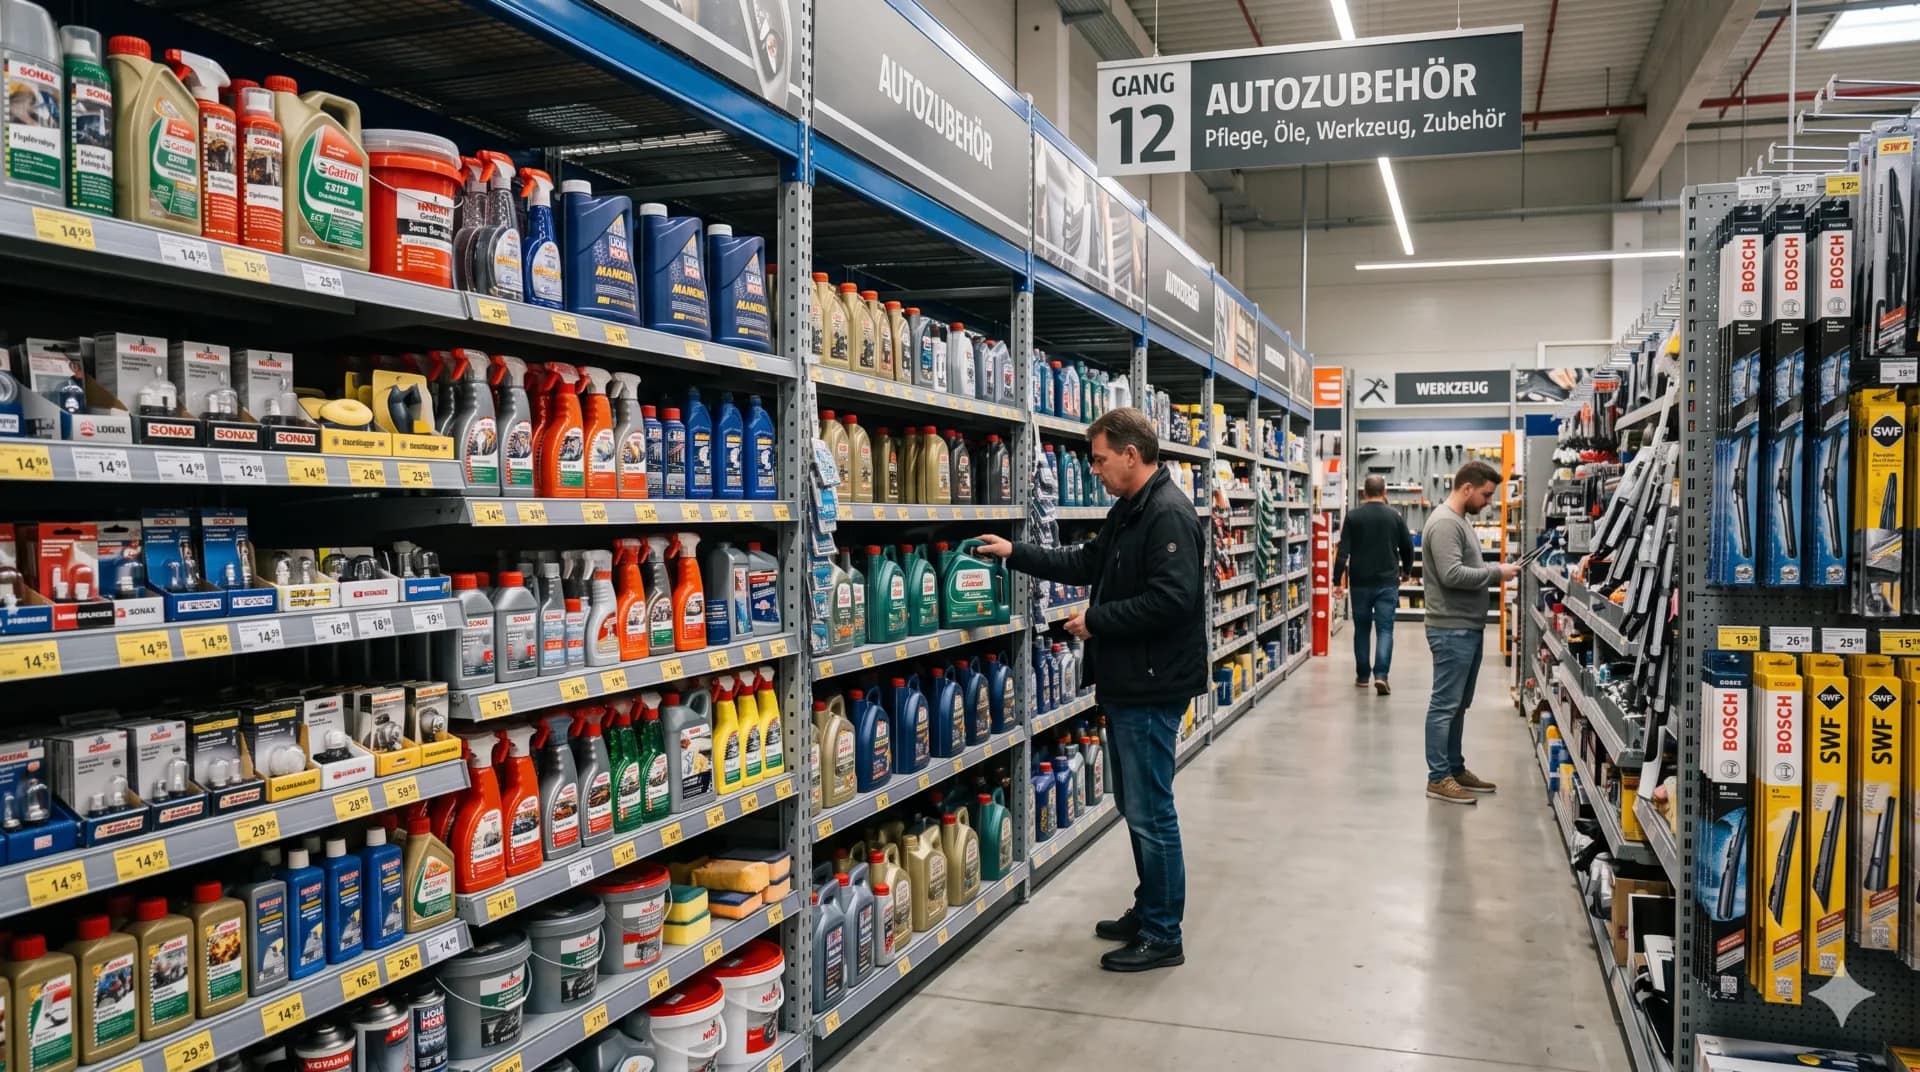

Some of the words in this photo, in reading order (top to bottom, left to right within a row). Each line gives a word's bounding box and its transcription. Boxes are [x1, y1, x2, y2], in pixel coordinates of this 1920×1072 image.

[1112, 72, 1174, 98] GANG
[1206, 57, 1477, 116] AUTOZUBEHÖR
[878, 53, 993, 170] AUTOZUBEHÖR
[1109, 104, 1175, 164] 12
[1205, 126, 1268, 149] Pflege,
[1274, 120, 1310, 145] Öle,
[1317, 116, 1416, 142] Werkzeug,
[1423, 109, 1507, 133] Zubehör
[1742, 239, 1756, 292] BOSCH
[1785, 237, 1798, 291] BOSCH
[1830, 235, 1844, 289] BOSCH
[1416, 381, 1489, 396] WERKZEUG
[150, 425, 193, 437] SONAX
[217, 429, 256, 440] SONAX
[278, 433, 314, 444] SONAX
[1873, 427, 1902, 437] SWF
[1820, 692, 1841, 701] SWF
[1872, 694, 1893, 702] SWF
[1722, 693, 1738, 751] BOSCH
[1777, 695, 1792, 754] BOSCH
[1820, 715, 1841, 764] SWF
[1871, 716, 1893, 765] SWF
